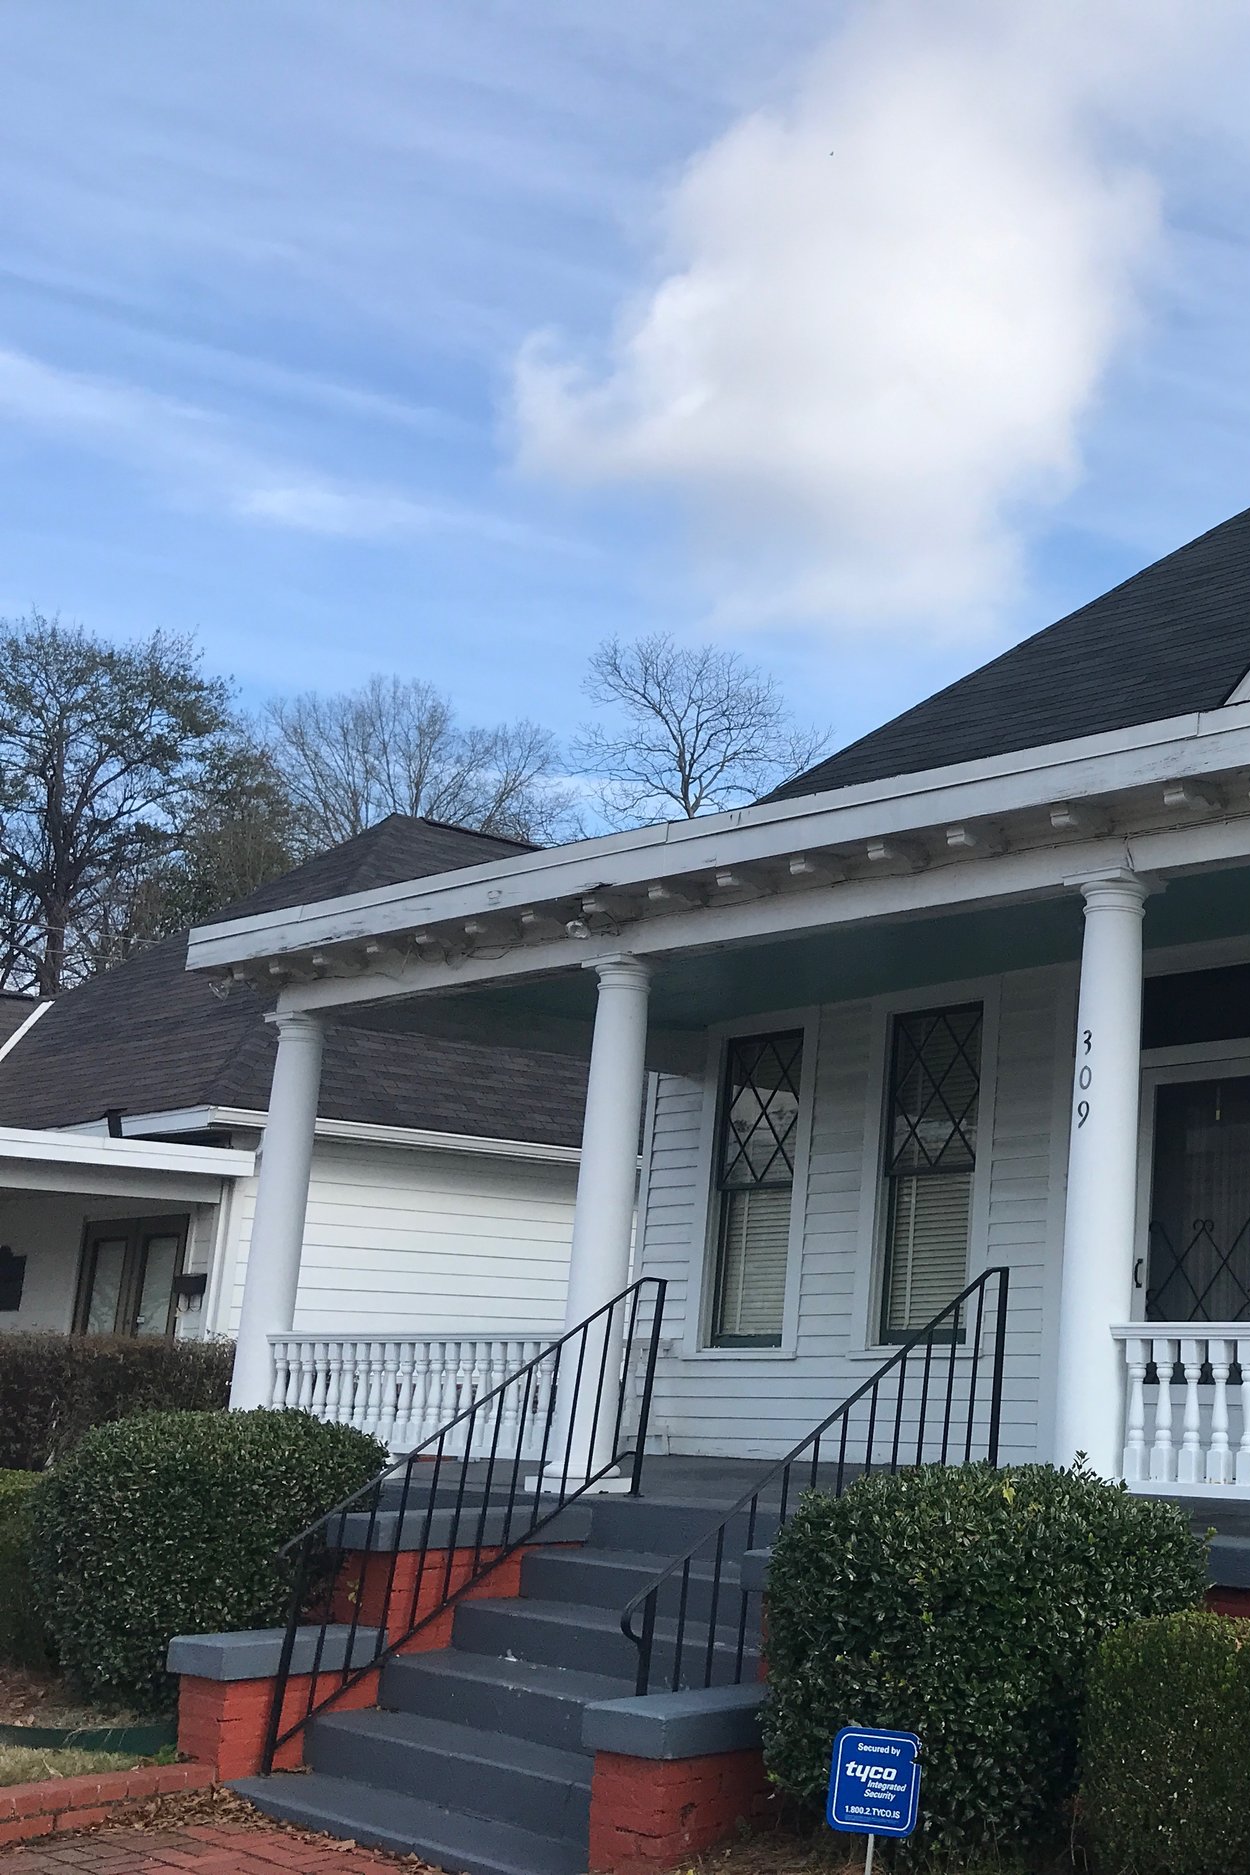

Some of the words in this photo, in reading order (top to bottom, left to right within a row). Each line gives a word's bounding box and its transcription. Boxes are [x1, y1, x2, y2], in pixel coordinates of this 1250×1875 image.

[1077, 1029, 1092, 1129] 309
[857, 1742, 890, 1754] Secured
[891, 1746, 901, 1757] by
[845, 1760, 897, 1782] tyco
[867, 1780, 907, 1792] Integrated
[863, 1789, 896, 1802] Security
[844, 1805, 901, 1819] 1.800.2.TYCO.IS
